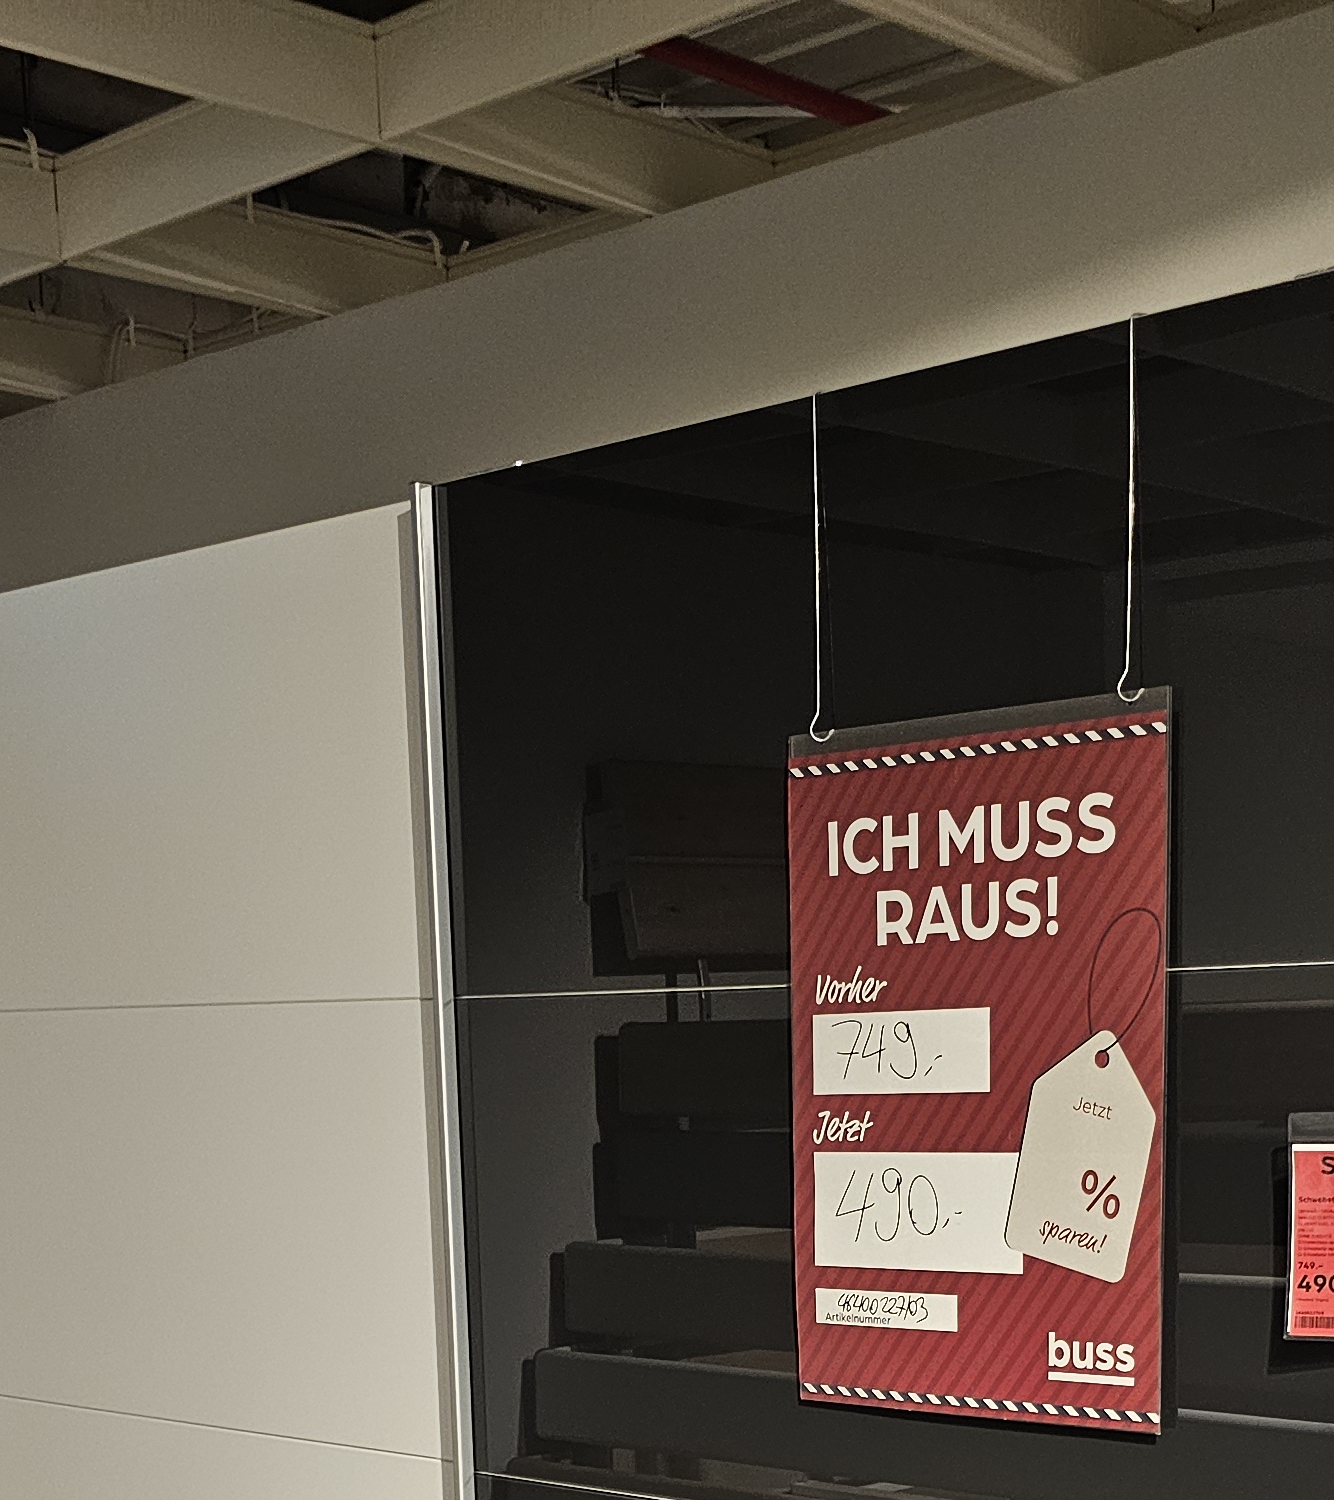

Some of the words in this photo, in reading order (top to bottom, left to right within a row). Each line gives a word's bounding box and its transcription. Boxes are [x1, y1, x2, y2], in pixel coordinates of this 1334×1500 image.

[827, 812, 919, 877] ICH
[938, 792, 1117, 867] MUSS
[875, 876, 1059, 947] RAUS!
[816, 965, 888, 1006] Vorher
[812, 1110, 874, 1145] Jetzt
[1072, 1096, 1113, 1121] Jetzt
[1081, 1169, 1121, 1220] %
[1038, 1220, 1107, 1254] sparen!
[825, 1312, 892, 1325] Artikelnummer
[1047, 1331, 1135, 1373] buss
